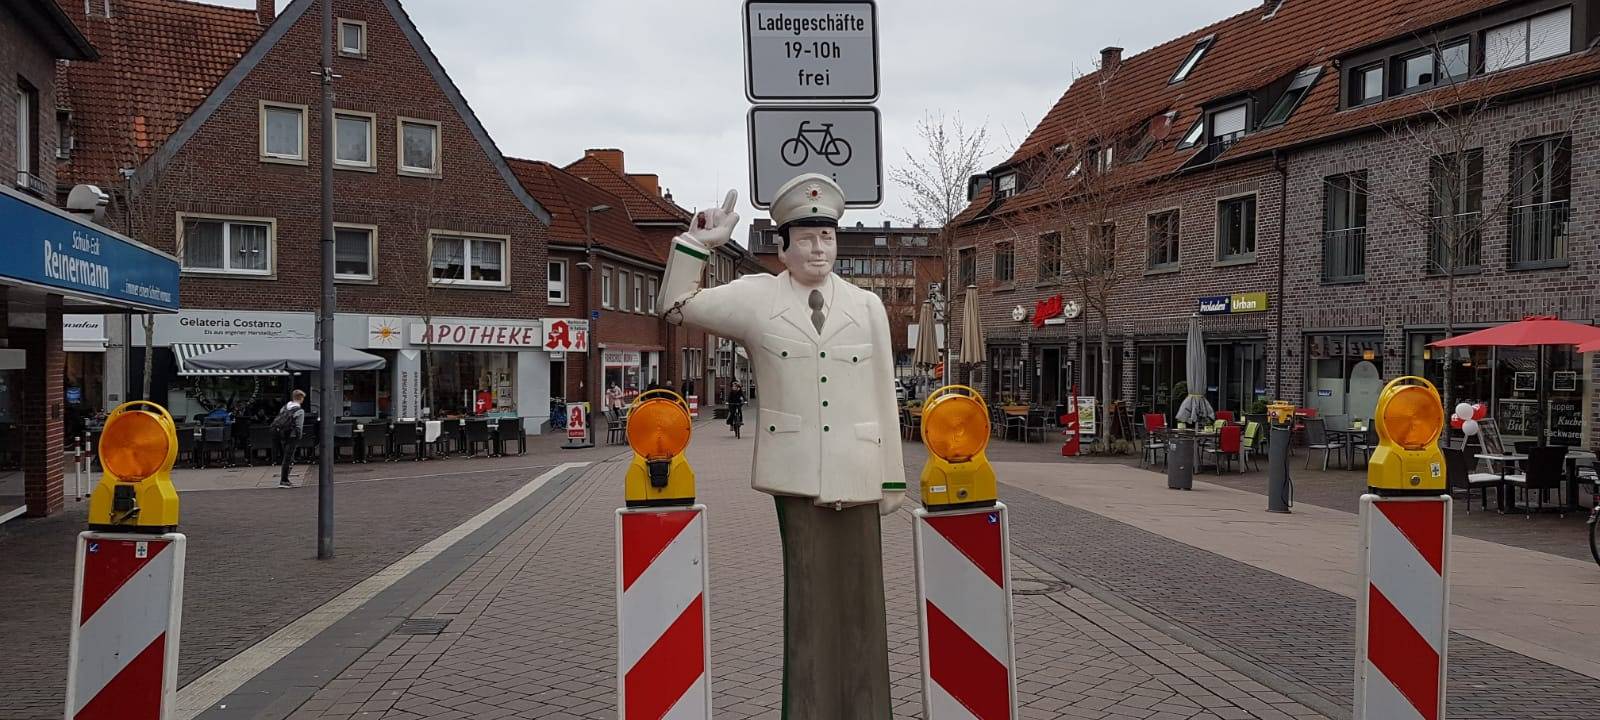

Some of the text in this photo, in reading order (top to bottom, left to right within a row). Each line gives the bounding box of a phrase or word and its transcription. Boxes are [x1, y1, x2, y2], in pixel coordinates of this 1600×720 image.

[758, 13, 865, 36] Ladegeschäfte
[784, 41, 841, 59] 19-10h
[798, 69, 830, 86] frei
[44, 239, 109, 290] Reinermann
[1233, 297, 1257, 310] Urban
[180, 317, 282, 329] Gelateria Costanzo
[422, 324, 533, 345] APOTHEKE
